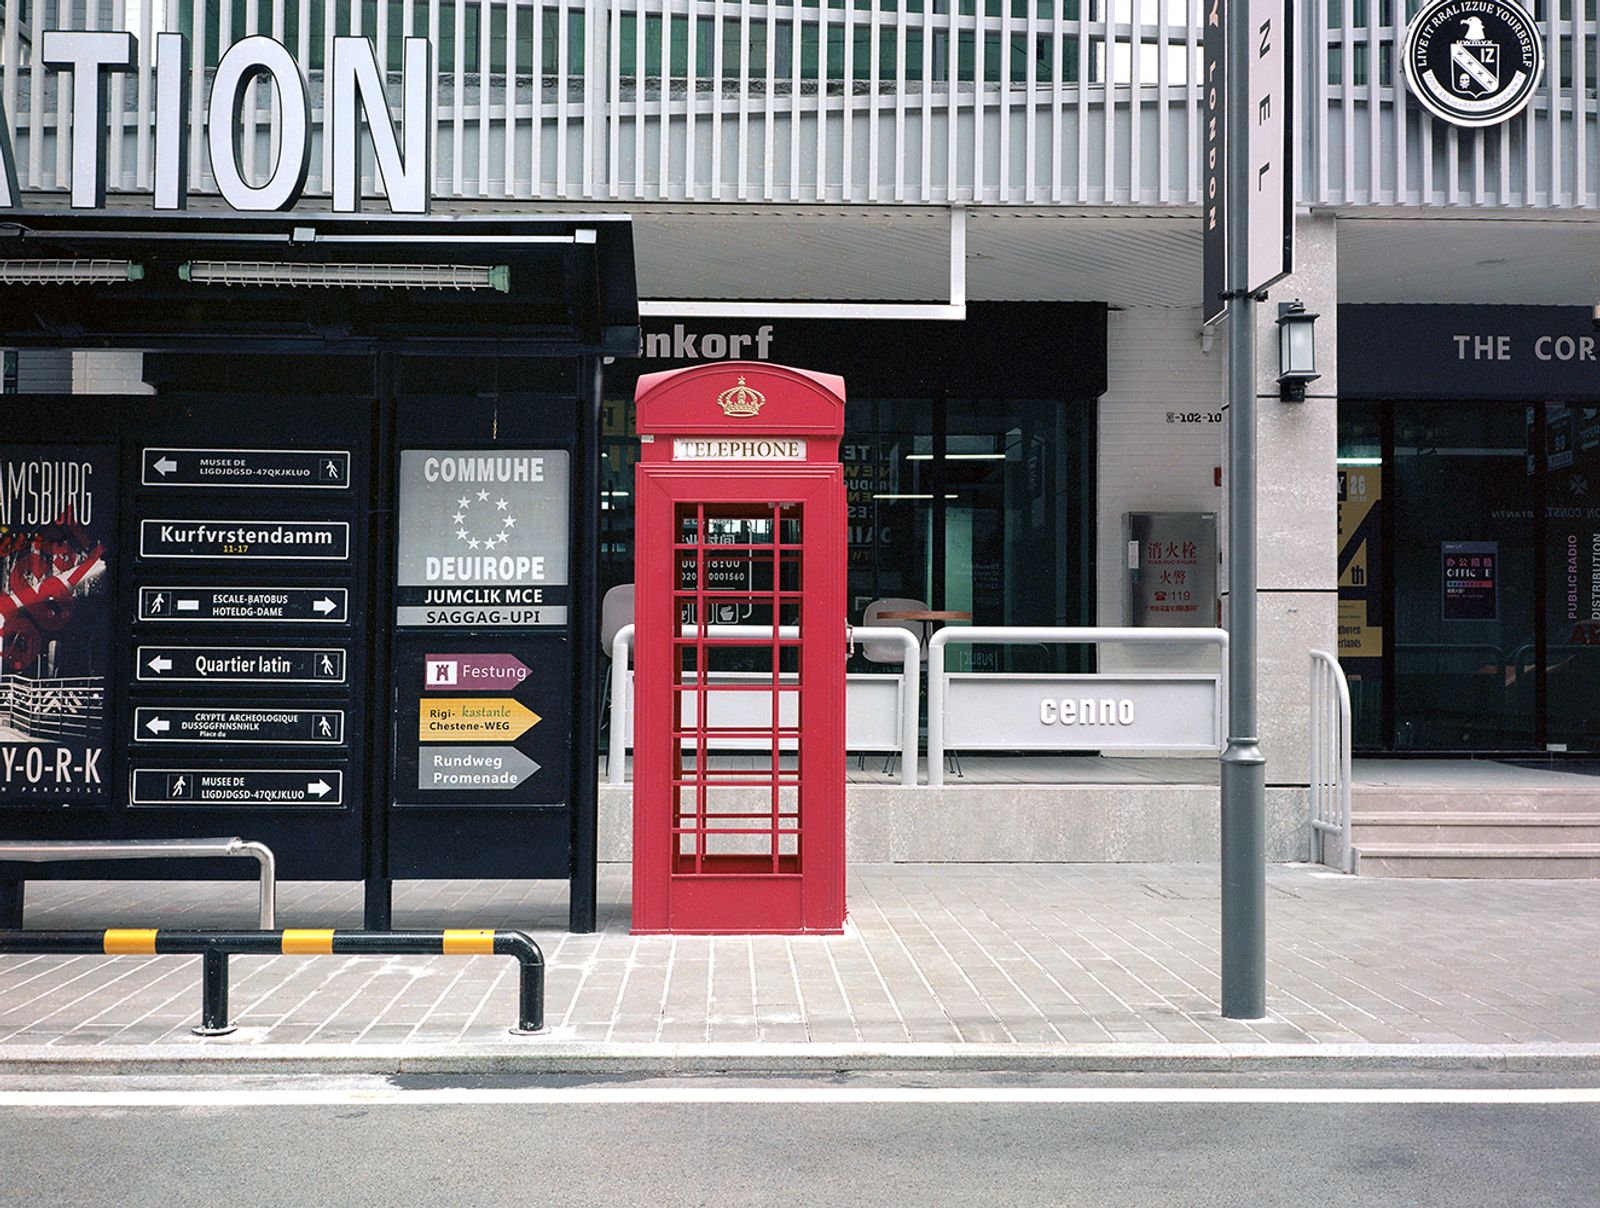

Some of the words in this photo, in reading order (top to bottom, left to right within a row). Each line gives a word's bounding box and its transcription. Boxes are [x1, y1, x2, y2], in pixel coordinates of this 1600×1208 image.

[1460, 1, 1495, 14] IZZUE
[1433, 5, 1460, 28] RRAL
[1423, 24, 1435, 39] IT
[1495, 6, 1533, 68] YOURBSELF
[1417, 38, 1430, 67] LIVE
[1480, 48, 1495, 63] IZ
[1209, 60, 1217, 231] LONDON
[603, 323, 773, 364] nkorf
[1453, 335, 1511, 360] THE
[1534, 335, 1597, 361] COR
[681, 441, 799, 457] TELEPHONE
[199, 459, 233, 467] MUSEE
[233, 459, 246, 467] DE
[424, 457, 544, 482] COMMUHE
[1349, 474, 1366, 496] 26
[160, 525, 332, 544] Kurfvrstendamm
[223, 545, 249, 553] 11-17
[1148, 541, 1196, 559] 消火栓
[1567, 534, 1578, 573] RADIO
[426, 556, 545, 581] DEUIROPE
[1591, 533, 1600, 620] DISTRIBUTION
[1159, 570, 1186, 585] 火警
[212, 594, 288, 605] ESCALE-BATOBUS
[424, 589, 501, 604] JUMCLIK
[505, 589, 543, 603] MCE
[1567, 574, 1578, 620] PUBLIC
[212, 606, 283, 617] HOTELDG-DAME
[426, 610, 540, 624] SAGGAG-UPI
[195, 655, 256, 676] Quartier
[258, 656, 291, 673] latin
[463, 665, 527, 681] Festung
[195, 713, 226, 722] CRYPTE
[229, 713, 298, 723] ARCHEOLOGIQUE
[430, 709, 455, 720] Rigi-
[1040, 698, 1135, 726] cenno
[199, 730, 217, 738] Place
[217, 730, 227, 738] du
[429, 721, 510, 731] Chestene-WEG
[433, 754, 503, 769] Rundweg
[201, 777, 232, 787] MUSEE
[233, 777, 245, 787] DE
[433, 771, 518, 784] Promenade
